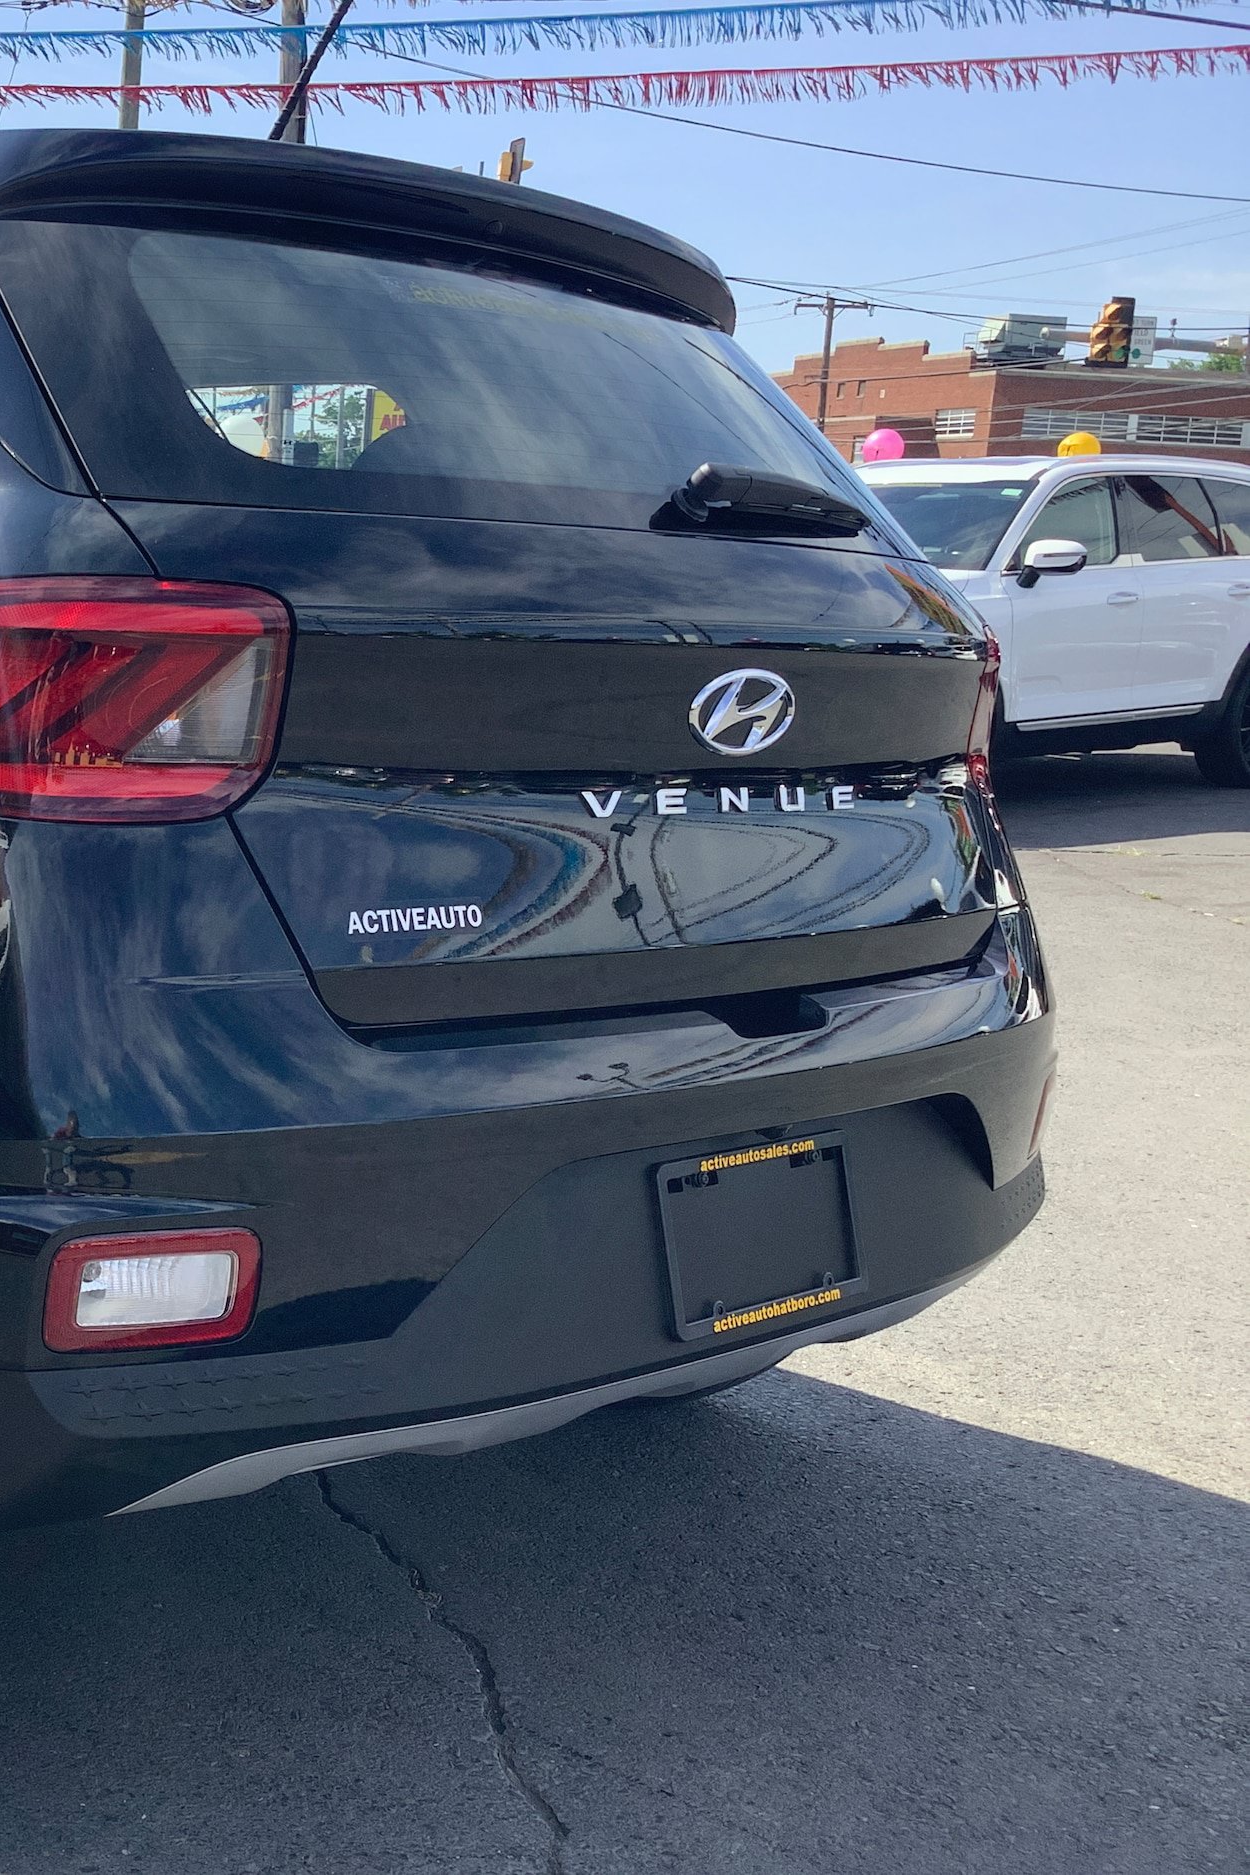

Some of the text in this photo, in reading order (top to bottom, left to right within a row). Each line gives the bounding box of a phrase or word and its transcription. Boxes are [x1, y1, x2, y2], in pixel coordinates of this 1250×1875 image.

[581, 785, 854, 818] VENUE
[348, 904, 483, 935] ACTIVEAUTO
[700, 1139, 814, 1172] activeautosales.com
[713, 1288, 841, 1333] activeautohatboro.com
